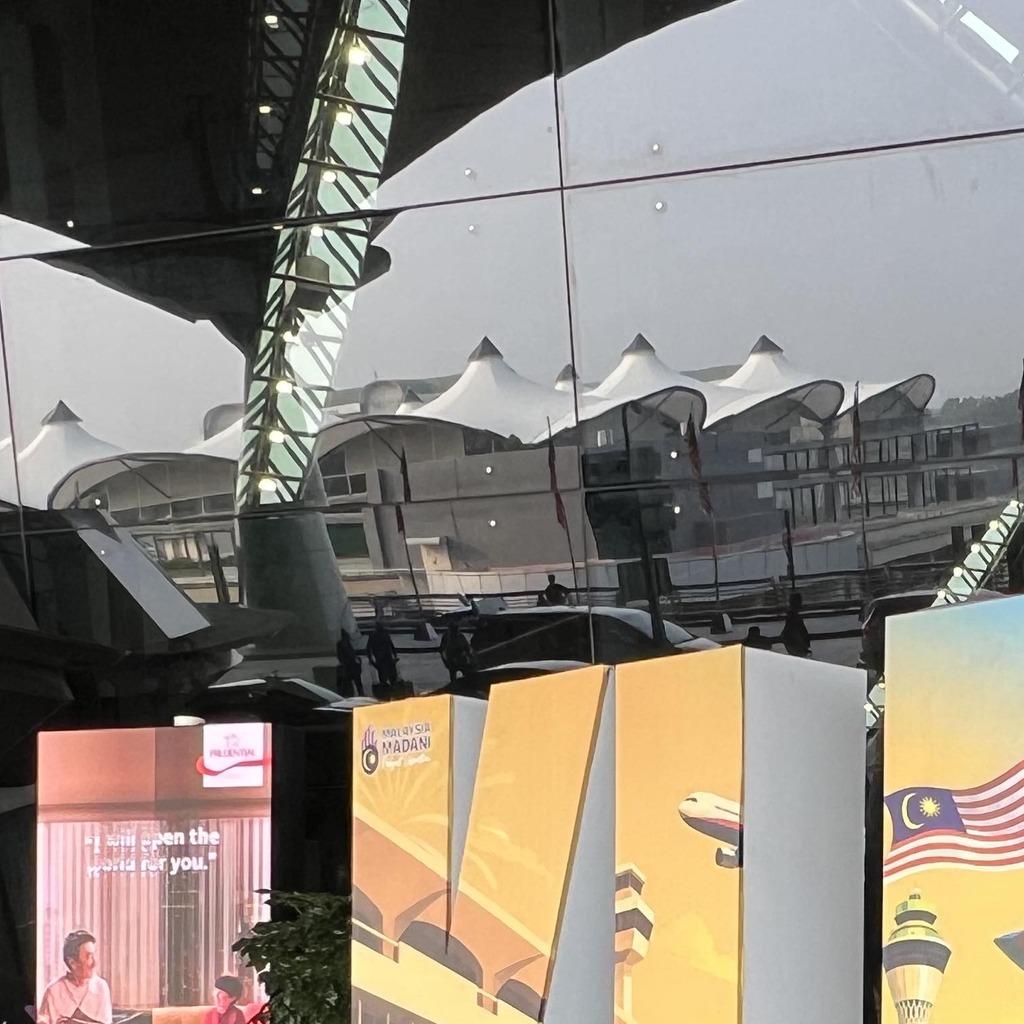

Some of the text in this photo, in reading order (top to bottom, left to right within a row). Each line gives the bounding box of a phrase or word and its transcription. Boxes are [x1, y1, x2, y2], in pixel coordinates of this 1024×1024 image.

[382, 722, 431, 738] MALAYSIA
[382, 736, 431, 754] MADANI
[189, 826, 220, 846] the
